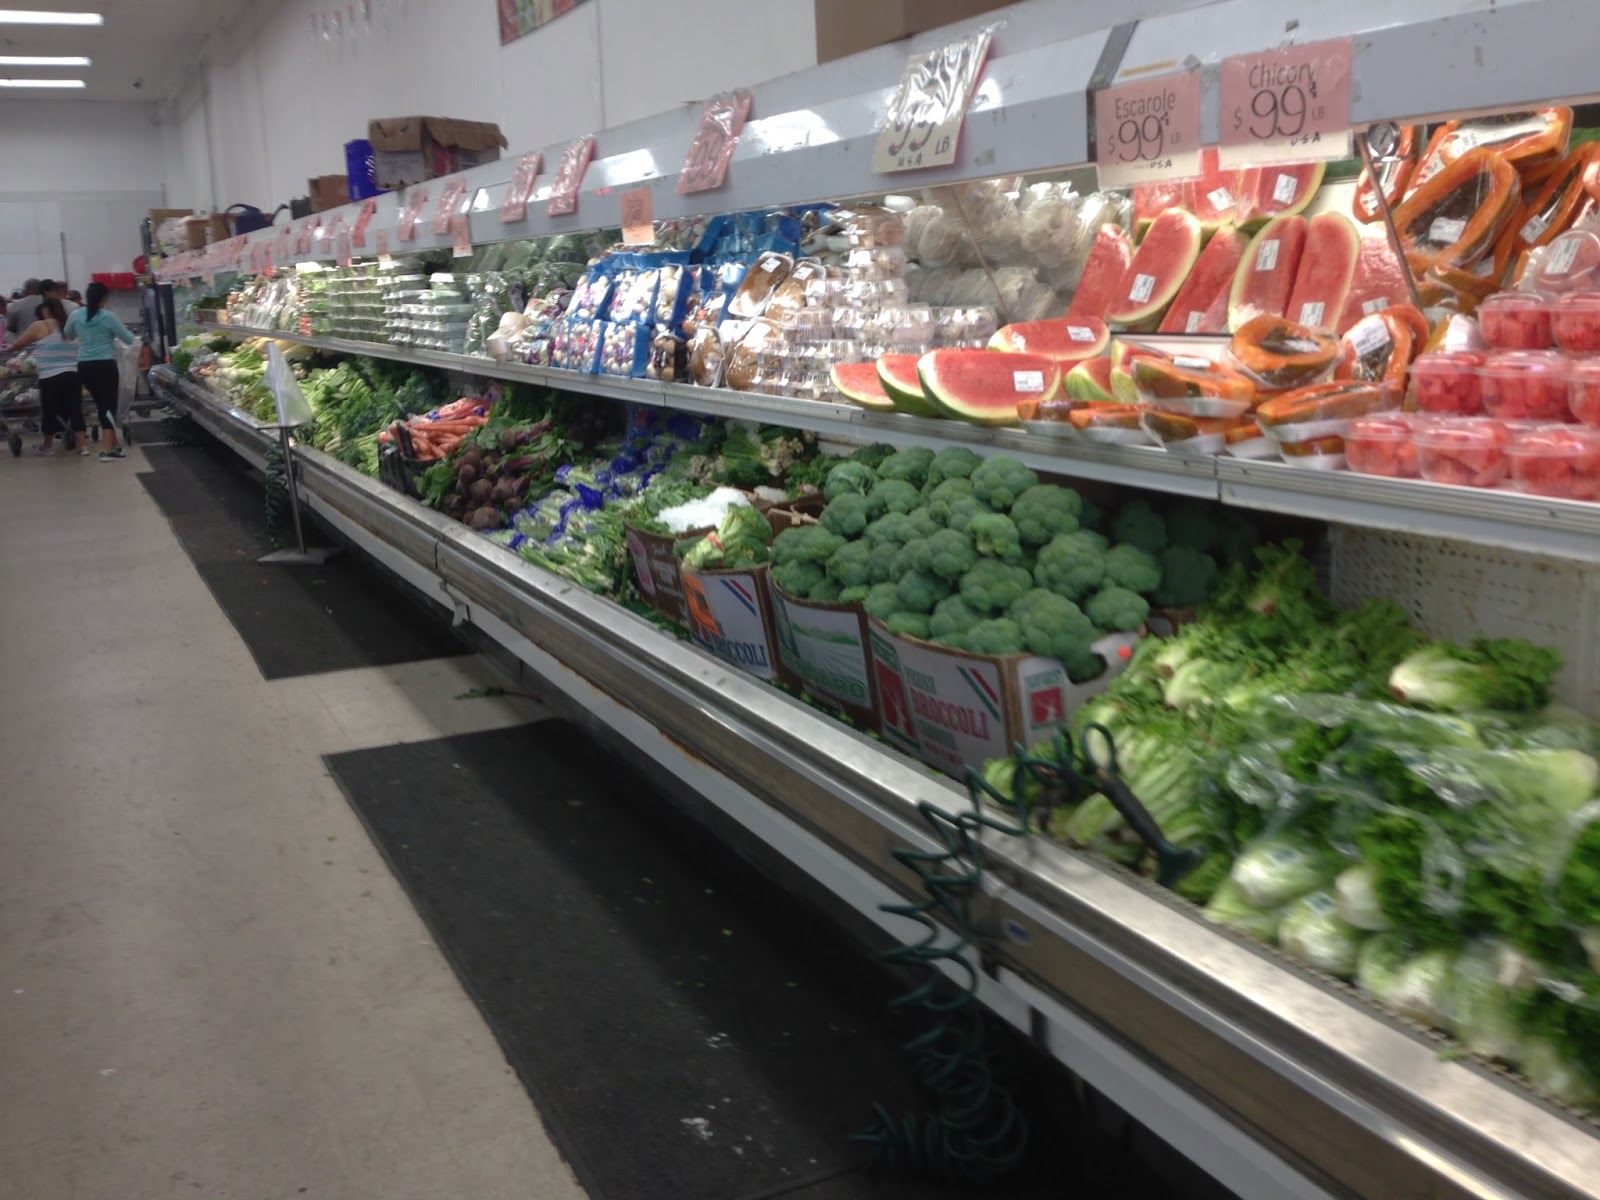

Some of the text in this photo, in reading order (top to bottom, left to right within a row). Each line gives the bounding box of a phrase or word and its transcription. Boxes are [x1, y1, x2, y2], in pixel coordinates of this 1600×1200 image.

[1249, 62, 1316, 89] Chicory
[1115, 88, 1176, 119] Escarole
[1311, 105, 1325, 120] LB
[934, 136, 950, 156] LB
[909, 687, 991, 741] BROCCOLI
